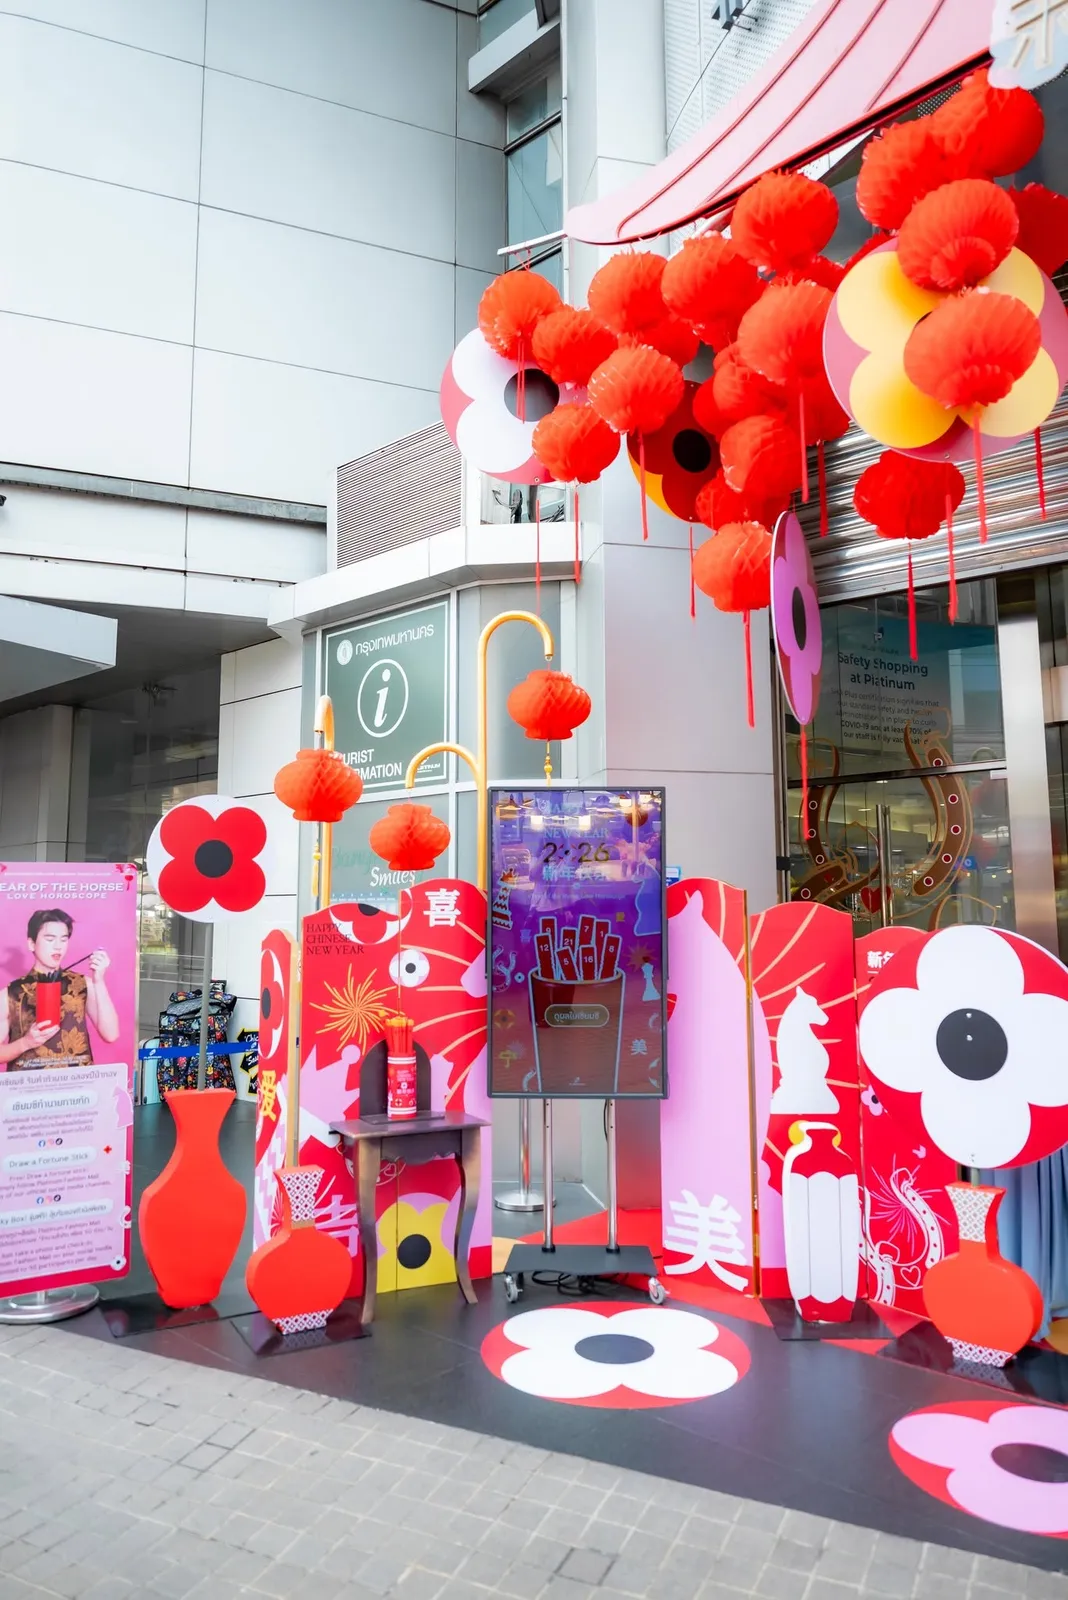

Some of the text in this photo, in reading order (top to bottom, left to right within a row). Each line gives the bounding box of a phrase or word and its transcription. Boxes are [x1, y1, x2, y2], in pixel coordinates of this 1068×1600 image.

[355, 624, 434, 657] กรุงเทพมหานคร
[837, 652, 929, 677] Safety Shopping
[850, 672, 915, 691] at Platinum
[925, 699, 939, 707] that
[841, 719, 869, 730] COVID-19
[891, 725, 905, 733] leas
[343, 749, 374, 765] URIST
[30, 882, 48, 892] OF
[51, 882, 77, 892] THE
[80, 882, 124, 892] HORSE
[7, 892, 107, 900] LOVE HOROSCOPE
[423, 887, 461, 928] 喜
[306, 923, 342, 933] HAPPY
[306, 933, 352, 944] CHINESE
[563, 938, 573, 946] 21
[306, 945, 365, 955] NEW YEAR
[539, 944, 549, 952] 12
[563, 957, 570, 966] 5
[9, 1158, 31, 1168] Draw
[38, 1155, 69, 1164] Fortune
[71, 1153, 88, 1161] Stick
[663, 1189, 749, 1292] 美
